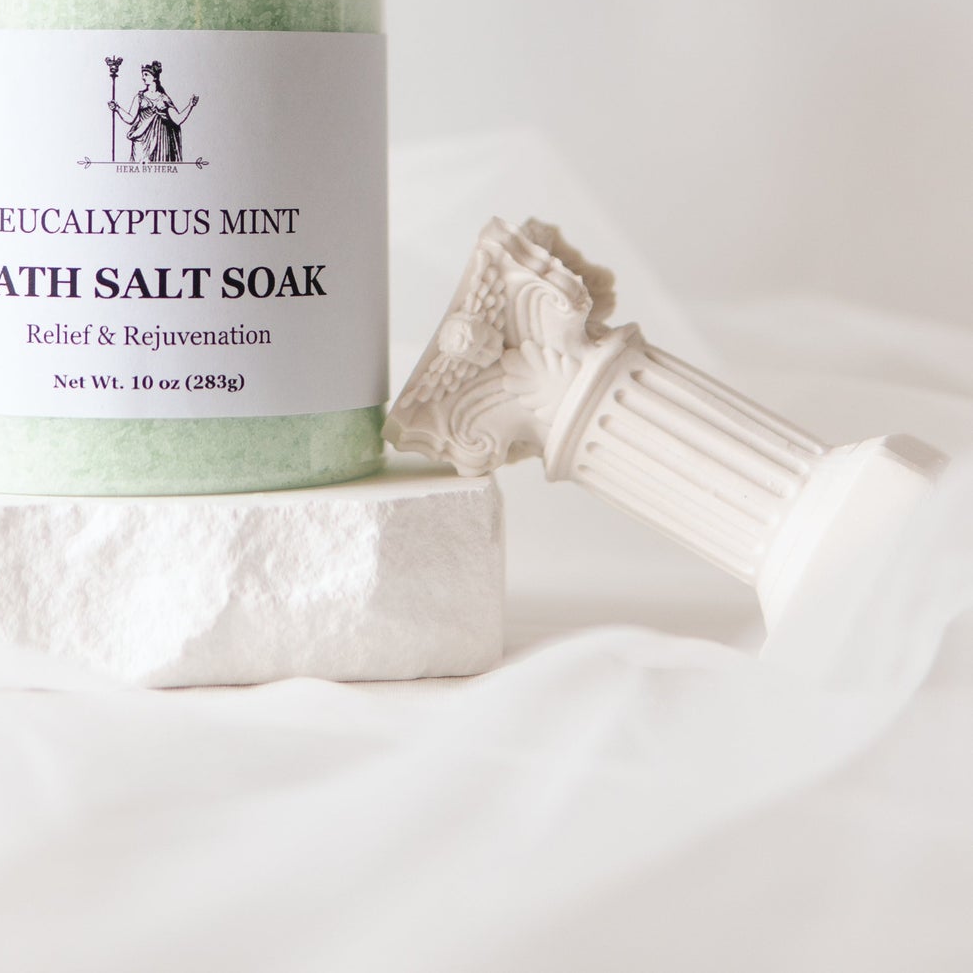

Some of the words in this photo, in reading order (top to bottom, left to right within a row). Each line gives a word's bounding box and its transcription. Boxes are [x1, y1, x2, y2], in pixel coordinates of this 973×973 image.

[116, 165, 140, 174] HERA
[142, 165, 153, 173] BY
[154, 165, 178, 173] HERA
[219, 209, 299, 234] MINT
[95, 267, 211, 299] SALT
[222, 265, 327, 299] SOAK
[27, 324, 93, 345] Relief
[98, 326, 116, 345] &
[124, 324, 271, 351] Rejuvenation
[54, 375, 85, 388] Net
[92, 376, 123, 389] Wt.
[133, 375, 153, 389] 10
[159, 380, 180, 389] oz
[185, 374, 244, 392] (283g)
